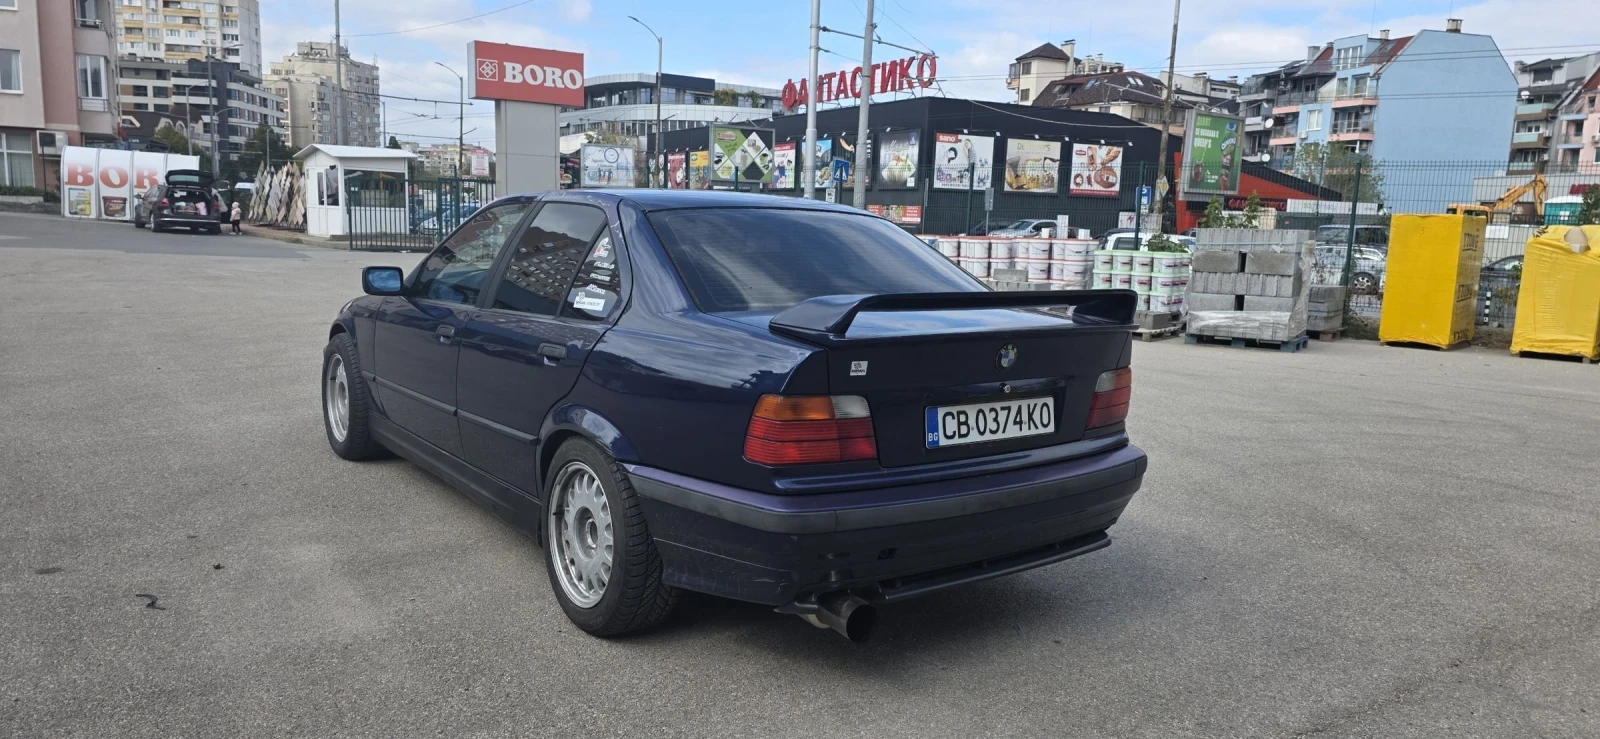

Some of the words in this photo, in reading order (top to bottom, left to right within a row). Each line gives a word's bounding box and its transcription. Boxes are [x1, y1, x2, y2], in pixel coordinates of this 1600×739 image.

[503, 61, 583, 90] BORO
[942, 410, 971, 440] CB
[975, 405, 1023, 437] 0374
[1027, 402, 1051, 430] KO
[928, 432, 938, 442] BG
